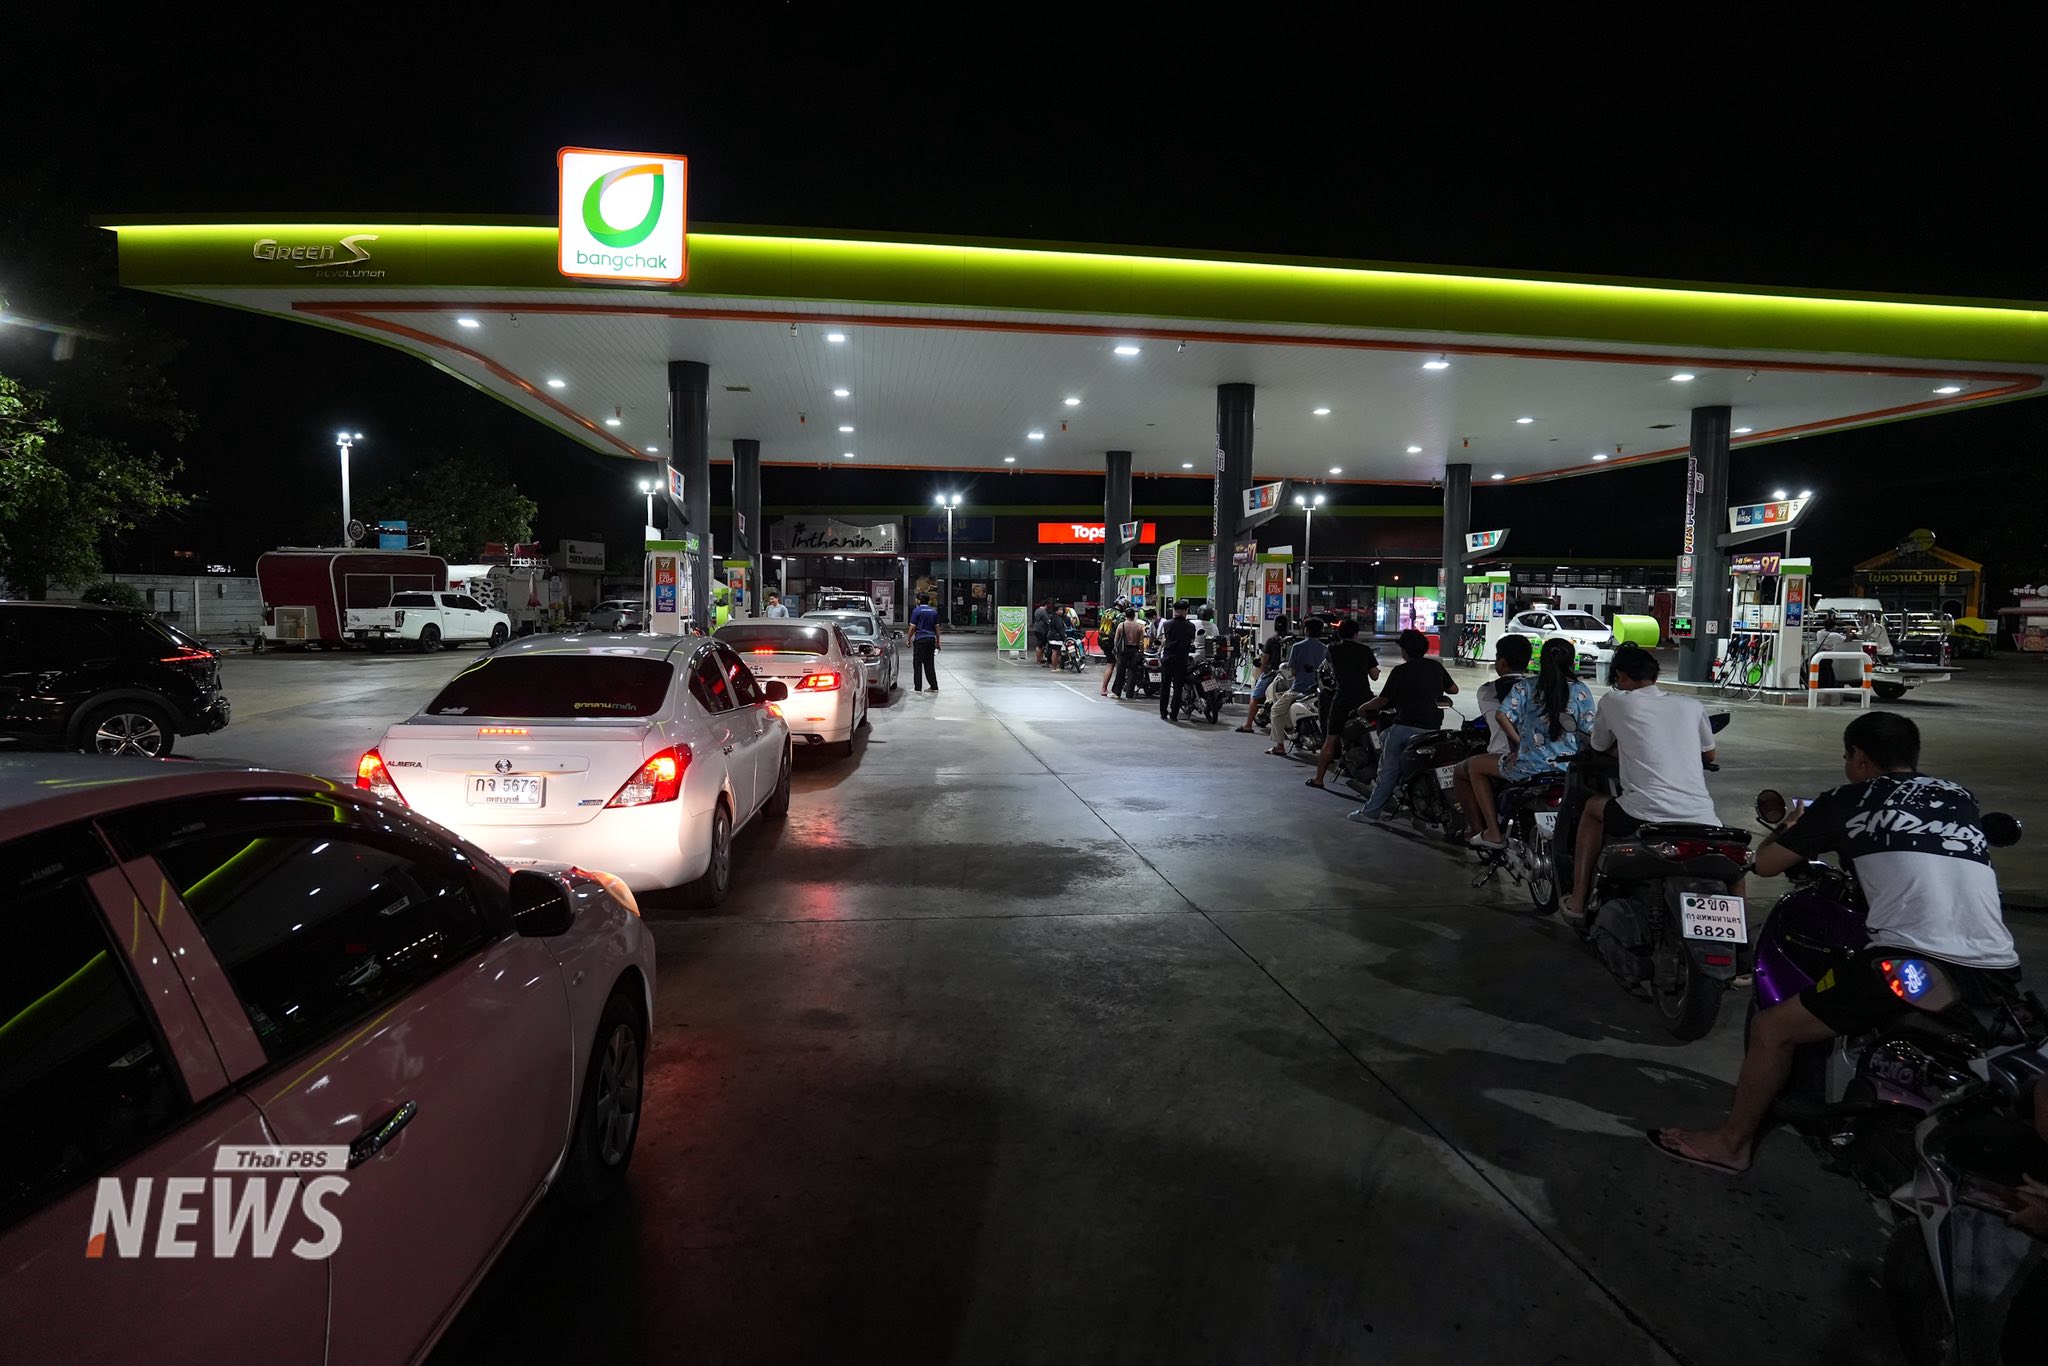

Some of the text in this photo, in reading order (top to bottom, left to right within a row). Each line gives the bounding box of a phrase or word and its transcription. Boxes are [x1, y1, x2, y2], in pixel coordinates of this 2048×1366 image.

[576, 250, 667, 271] bangchak
[1793, 501, 1798, 511] 5
[792, 522, 872, 548] Inthanin
[1071, 525, 1106, 541] Tops
[660, 561, 671, 569] 97
[1761, 556, 1779, 573] 97
[1868, 571, 1958, 586] ไข่หวานบ้านซูชิ
[386, 760, 423, 768] ALMERA
[475, 778, 538, 792] กจ 5676
[1686, 912, 1742, 924] กรุงเทพมหานคร
[1693, 925, 1736, 938] 6829
